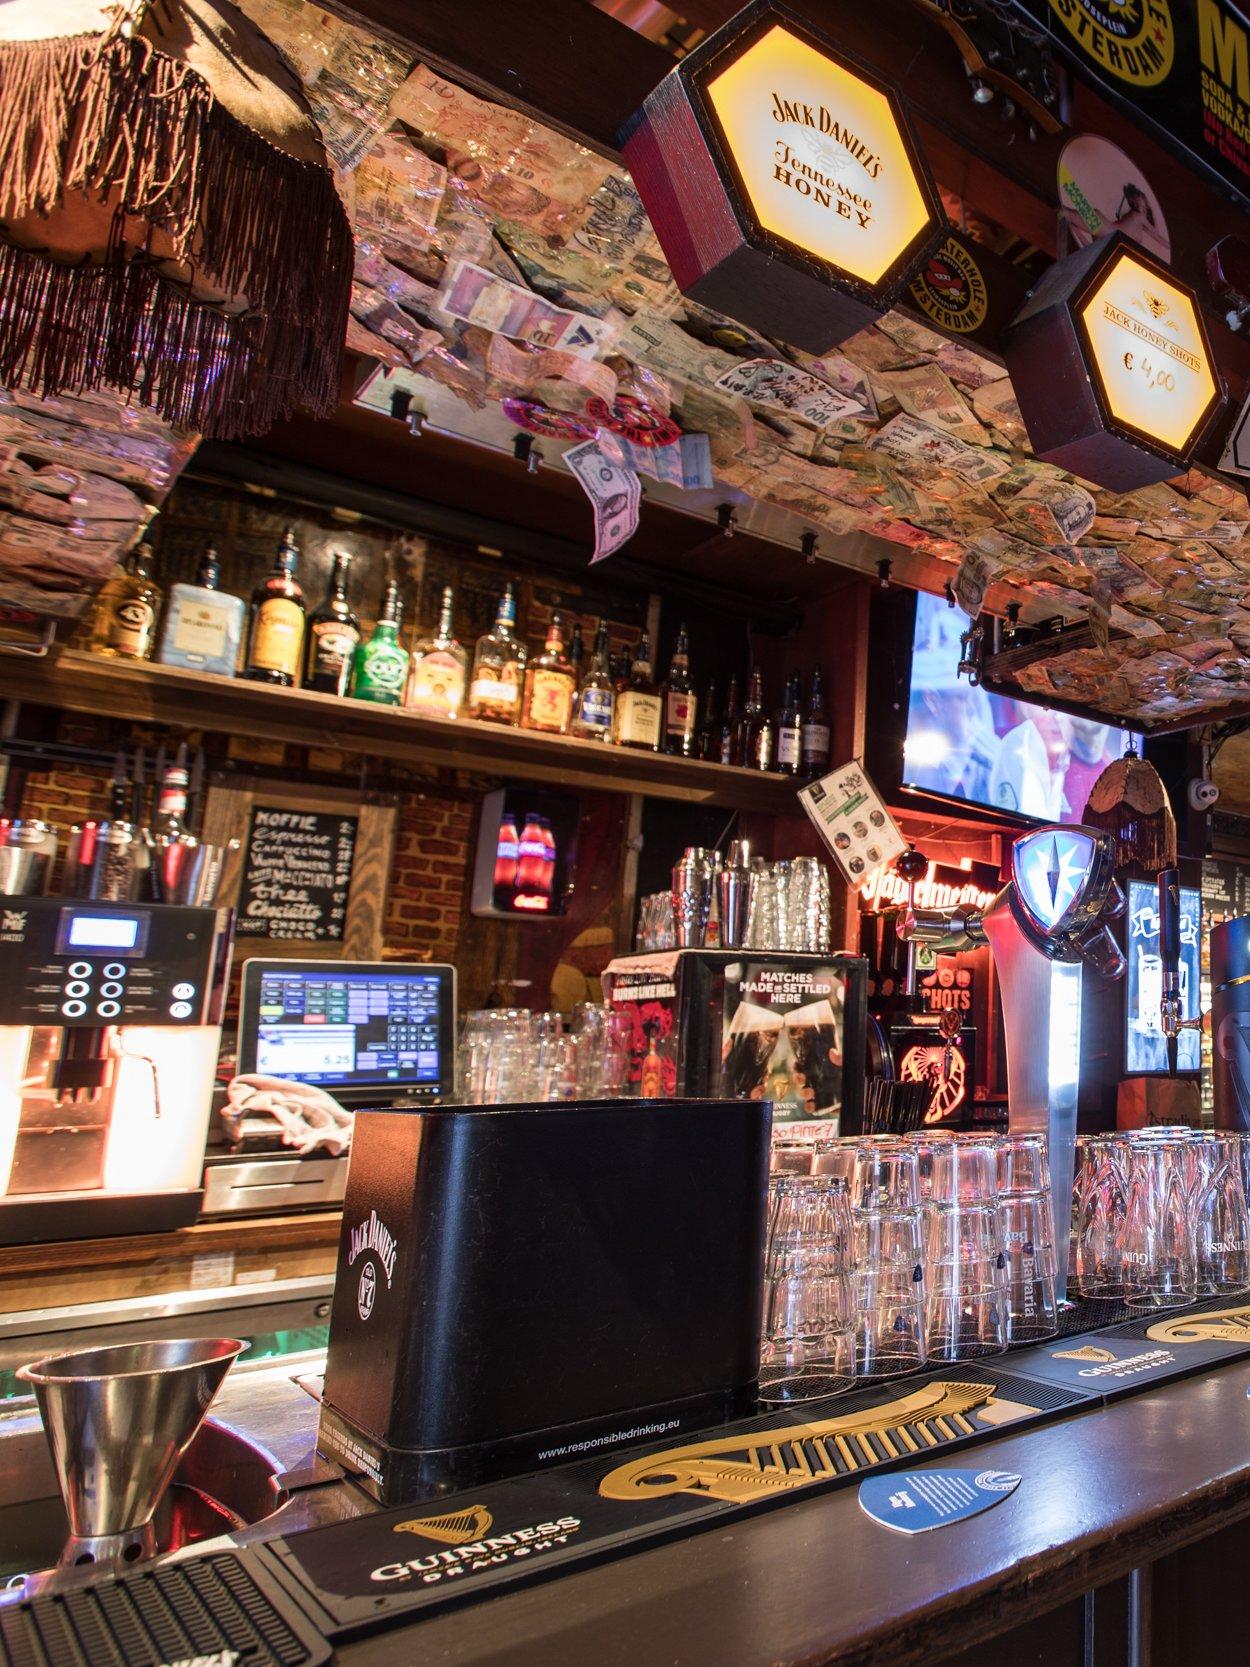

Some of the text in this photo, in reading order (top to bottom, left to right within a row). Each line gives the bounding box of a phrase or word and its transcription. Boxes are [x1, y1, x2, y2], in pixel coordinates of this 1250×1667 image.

[1057, 0, 1165, 77] STERDAM
[1201, 71, 1233, 112] SODA
[1236, 104, 1247, 120] &
[772, 93, 883, 181] JACK DANIEL'S
[772, 164, 871, 230] HONEY
[775, 140, 872, 211] Tennessee
[912, 281, 979, 330] MSTERDAM
[1103, 306, 1201, 371] JACK HONEY SHOTS
[1122, 351, 1134, 371] €
[255, 811, 318, 831] KOFFIE
[739, 982, 774, 992] MADE
[782, 984, 831, 994] SETTLED
[760, 972, 813, 983] MATCHES
[770, 994, 801, 1003] HERE
[773, 1102, 798, 1110] INNESS
[1021, 1257, 1034, 1318] Bavaria
[1078, 1349, 1170, 1377] GUINNESS
[1114, 1356, 1176, 1378] DRAUGHT
[538, 1418, 680, 1460] www.responsibledrinking.eu
[370, 1516, 582, 1582] GUINNESS
[422, 1535, 570, 1584] DRAUGHT
